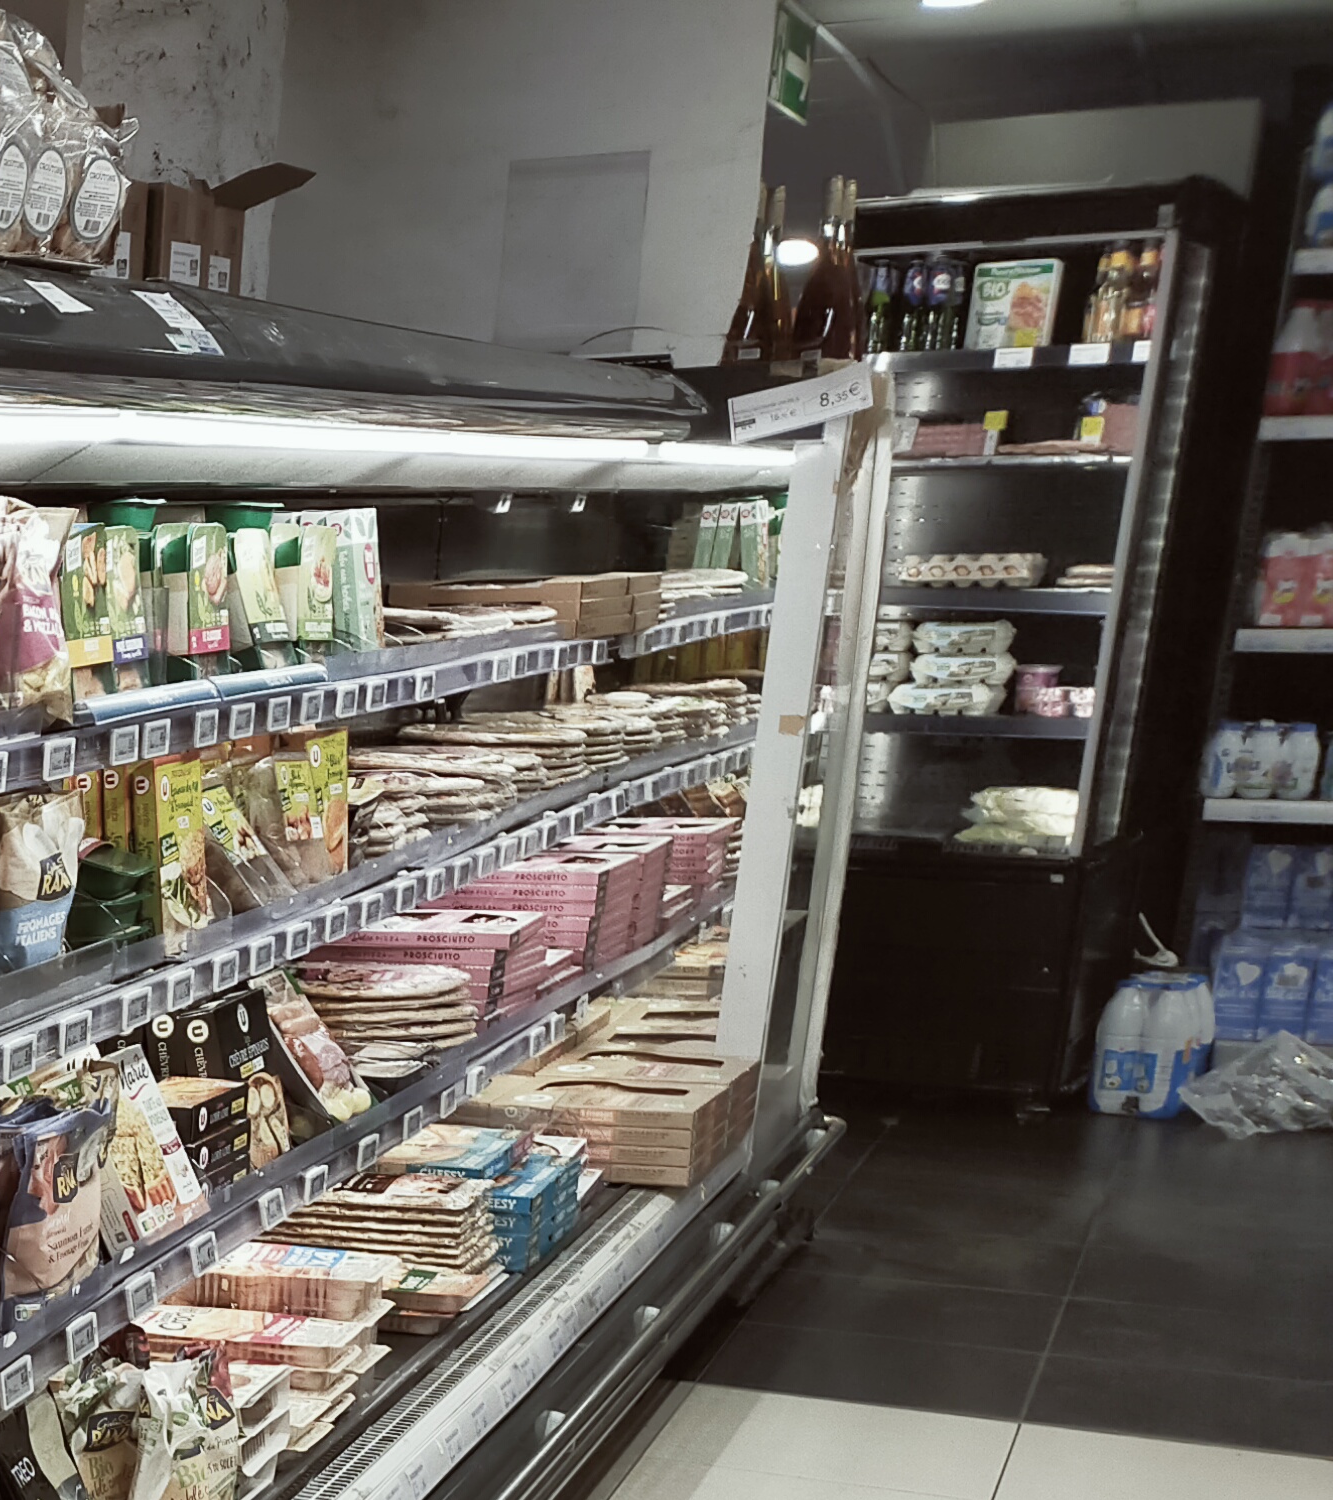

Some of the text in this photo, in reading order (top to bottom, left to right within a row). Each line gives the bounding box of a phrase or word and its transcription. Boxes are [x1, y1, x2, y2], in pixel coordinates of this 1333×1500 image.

[514, 872, 569, 883] PROSCIUTTO
[512, 888, 566, 899] PROSCIUTTO
[16, 910, 67, 935] FROMAGES
[14, 926, 58, 948] ITALIENS
[416, 934, 476, 945] PROSCIUTTO
[403, 950, 461, 963] PROSCIUTTO
